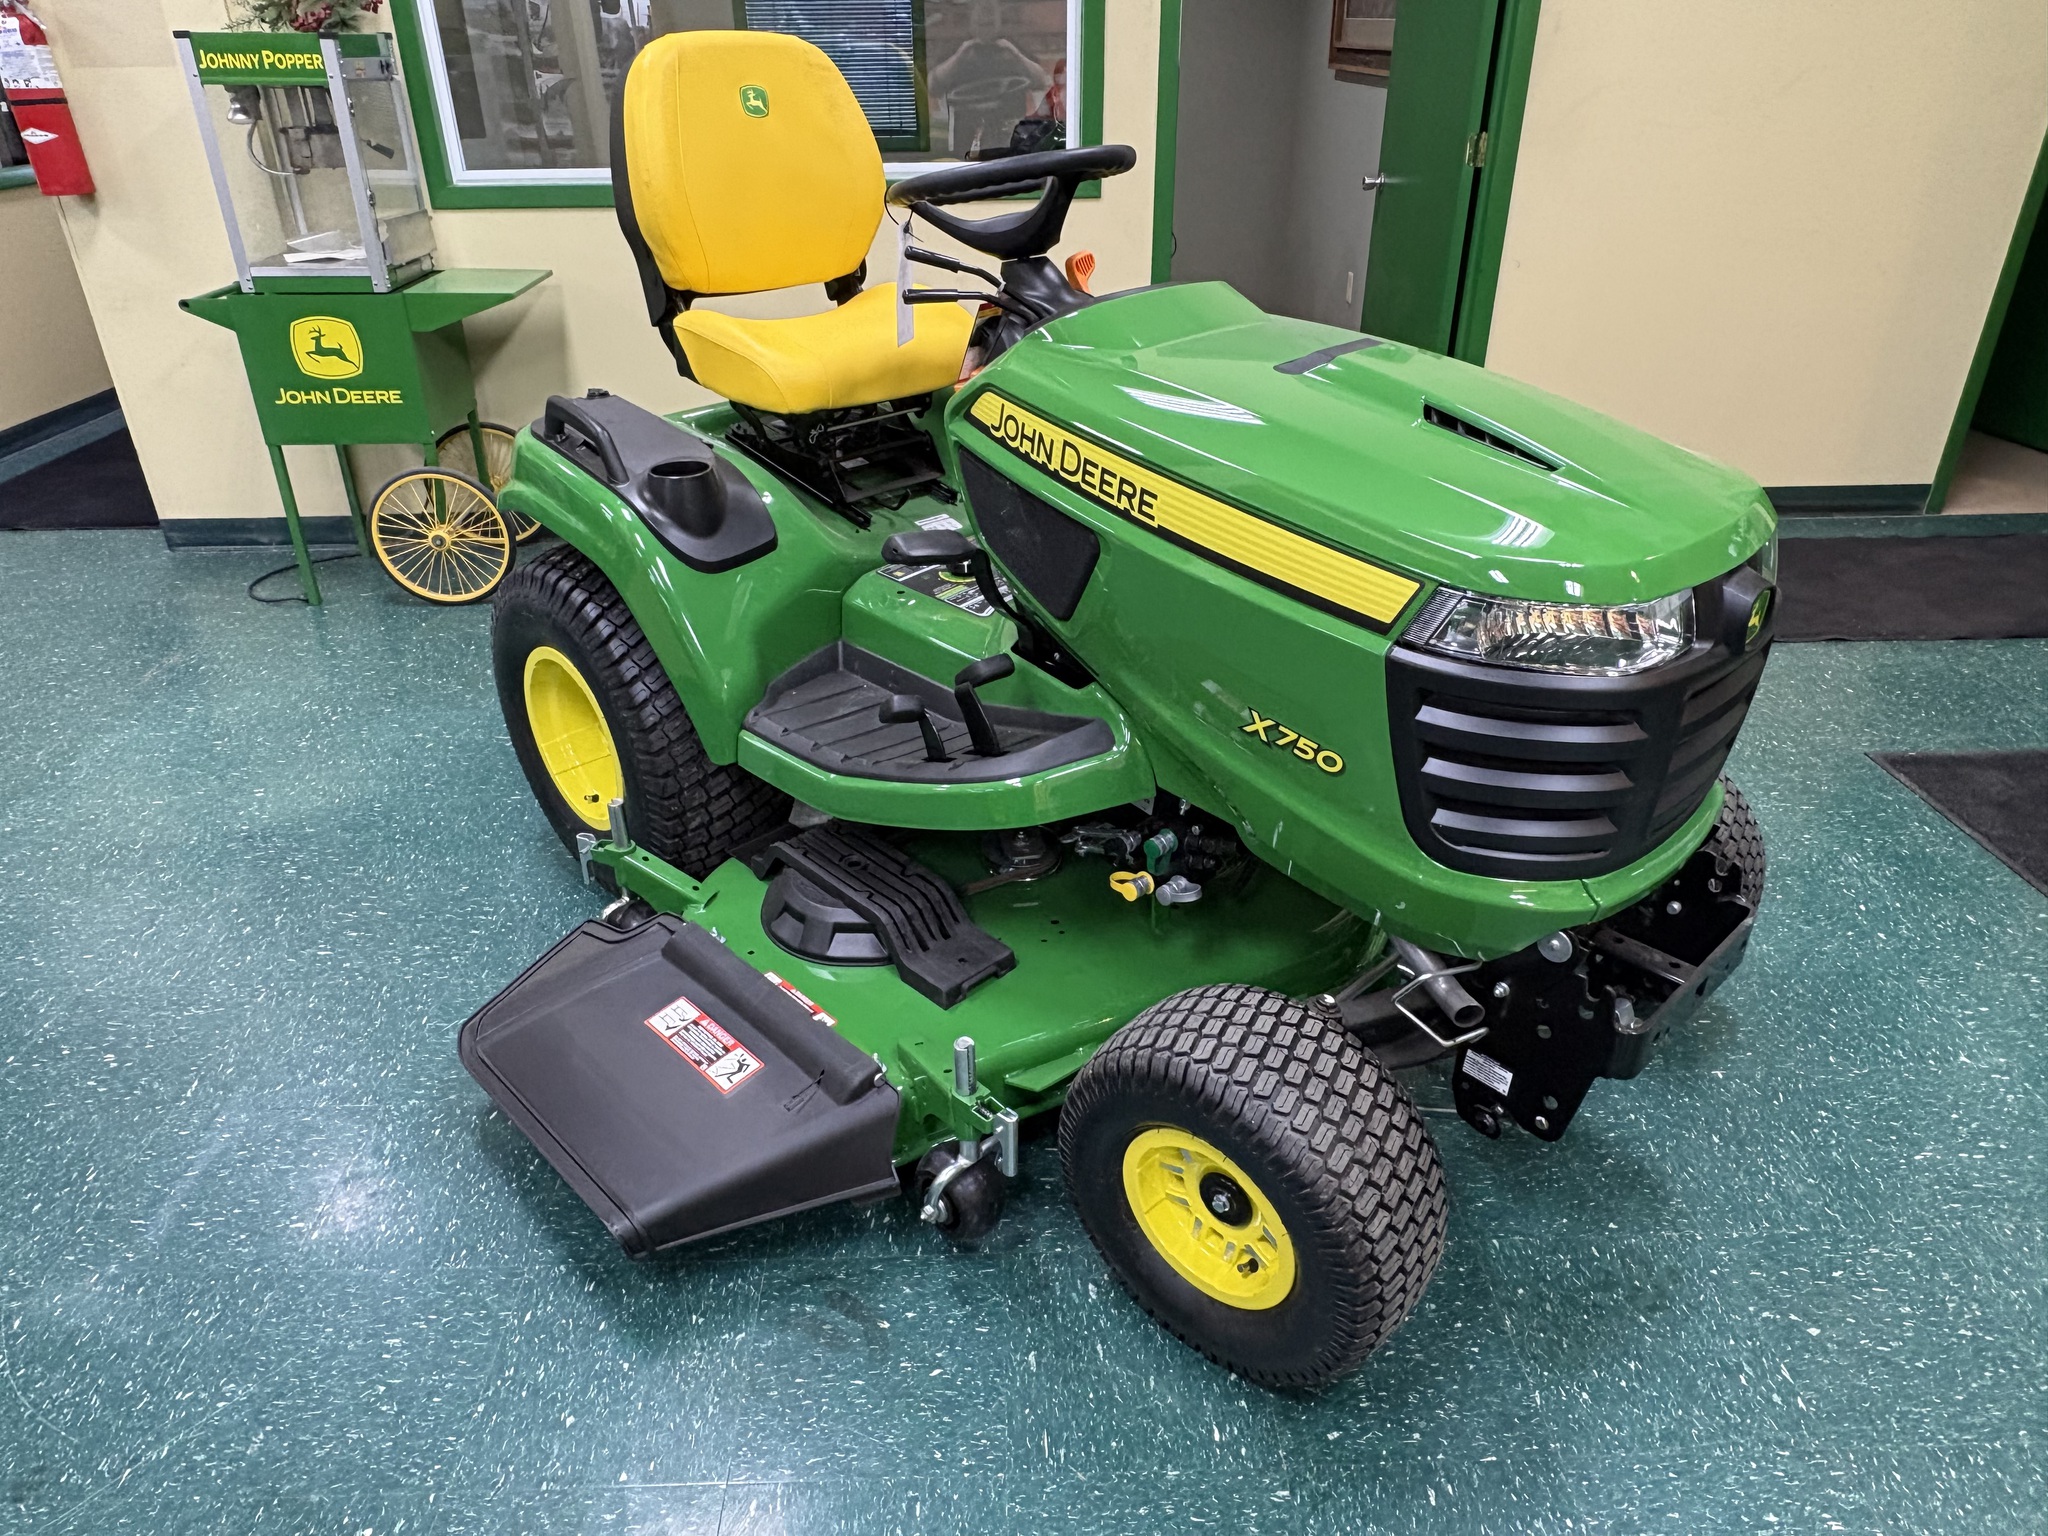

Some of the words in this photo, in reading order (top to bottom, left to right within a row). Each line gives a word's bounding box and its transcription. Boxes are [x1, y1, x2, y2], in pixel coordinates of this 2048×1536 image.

[199, 49, 259, 69] JOHNNY
[261, 50, 324, 69] POPPER
[275, 387, 331, 404] JOHN
[332, 387, 403, 404] DEERE
[990, 403, 1055, 466] JOHN
[1060, 439, 1158, 522] DEERE
[1240, 707, 1344, 773] X750
[706, 1021, 735, 1047] DANGER
